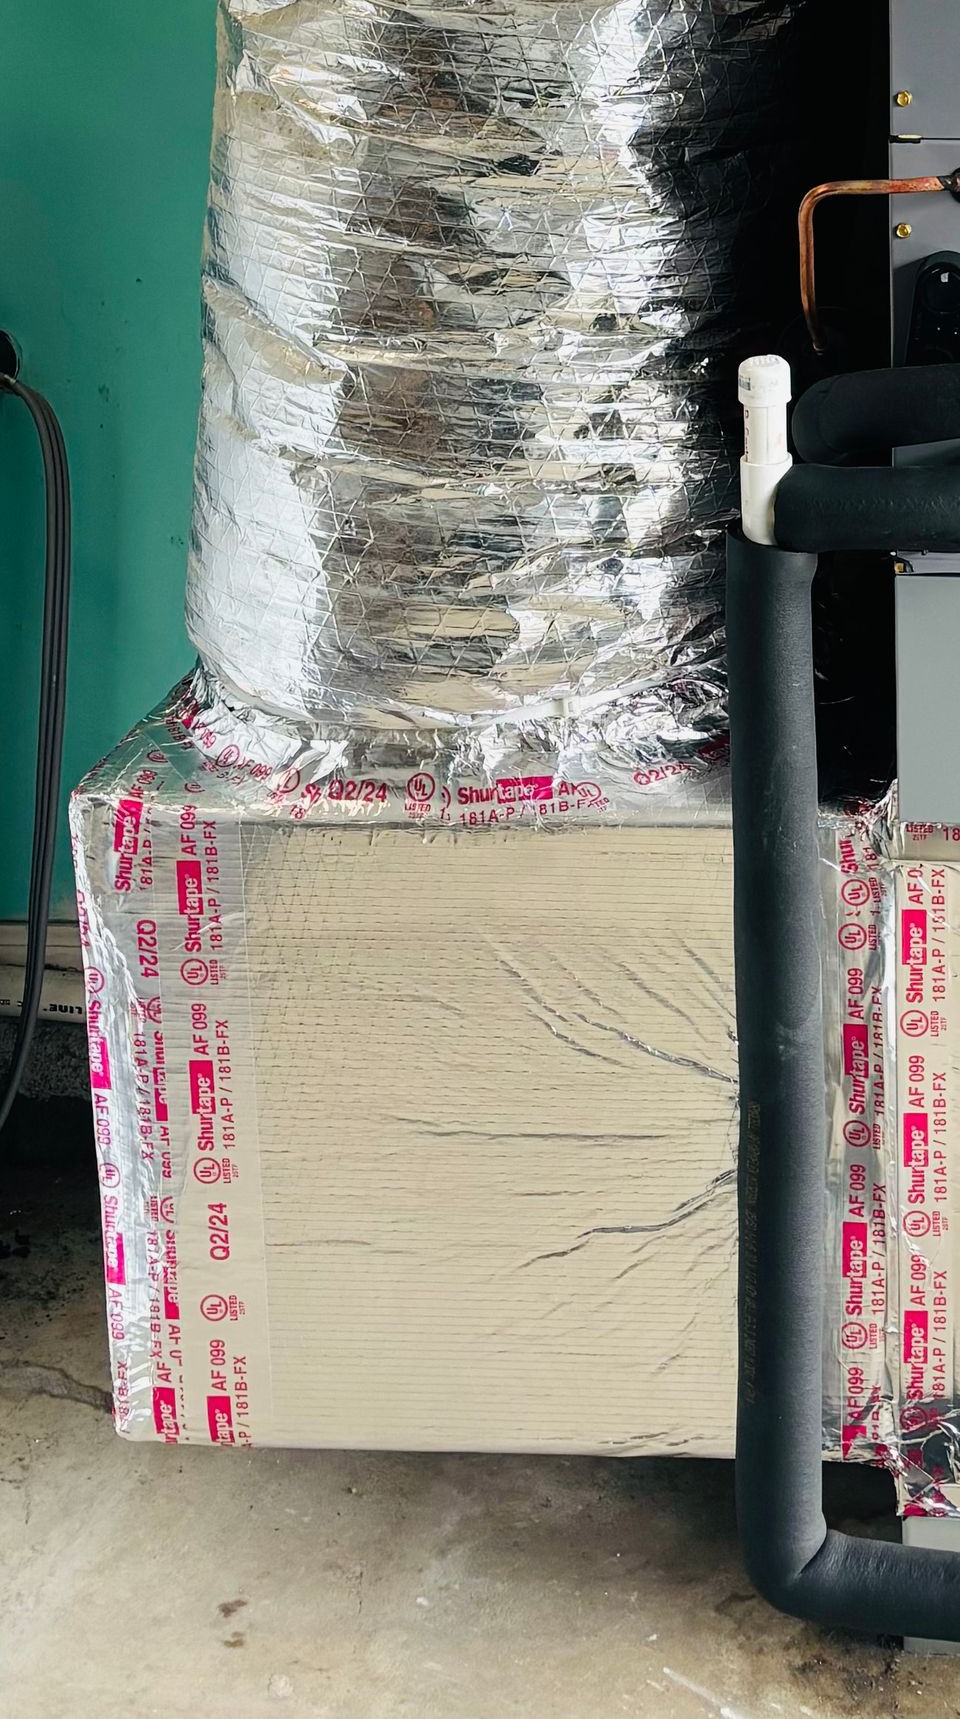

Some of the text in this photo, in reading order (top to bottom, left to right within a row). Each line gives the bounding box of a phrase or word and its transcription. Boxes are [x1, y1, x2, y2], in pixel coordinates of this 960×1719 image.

[329, 780, 387, 802] Q2/24
[458, 782, 534, 805] Shurtape
[181, 834, 202, 953] Shurtape AF
[203, 820, 223, 951] 181A-P 181B-FX
[906, 883, 925, 1003] Shurtape AF
[932, 869, 945, 1002] 181A-P 181B-FX
[136, 919, 159, 977] Q2/24
[191, 1003, 215, 1151] Shurtape AF 099
[847, 968, 867, 1116] Shurtape AF 099
[930, 1011, 938, 1037] LISTED
[216, 1020, 235, 1150] 181A-P 181B-FX
[907, 1055, 926, 1204] Shurtape AF 099
[933, 1072, 947, 1202] 181A-P 181B-FX
[222, 1158, 231, 1183] LISTED
[932, 1210, 941, 1236] LISTED
[208, 1203, 230, 1261] Q2/24
[847, 1164, 866, 1316] Shurtape AF 099
[872, 1184, 886, 1315] 181A-P 181B-FX
[210, 1339, 227, 1391] AF 099
[229, 1295, 238, 1321] LISTED
[907, 1282, 926, 1400] Shurtape AF
[932, 1271, 947, 1398] 181A-P 181B-FX
[234, 1357, 249, 1416] 181B-FX
[848, 1367, 863, 1394] 099
